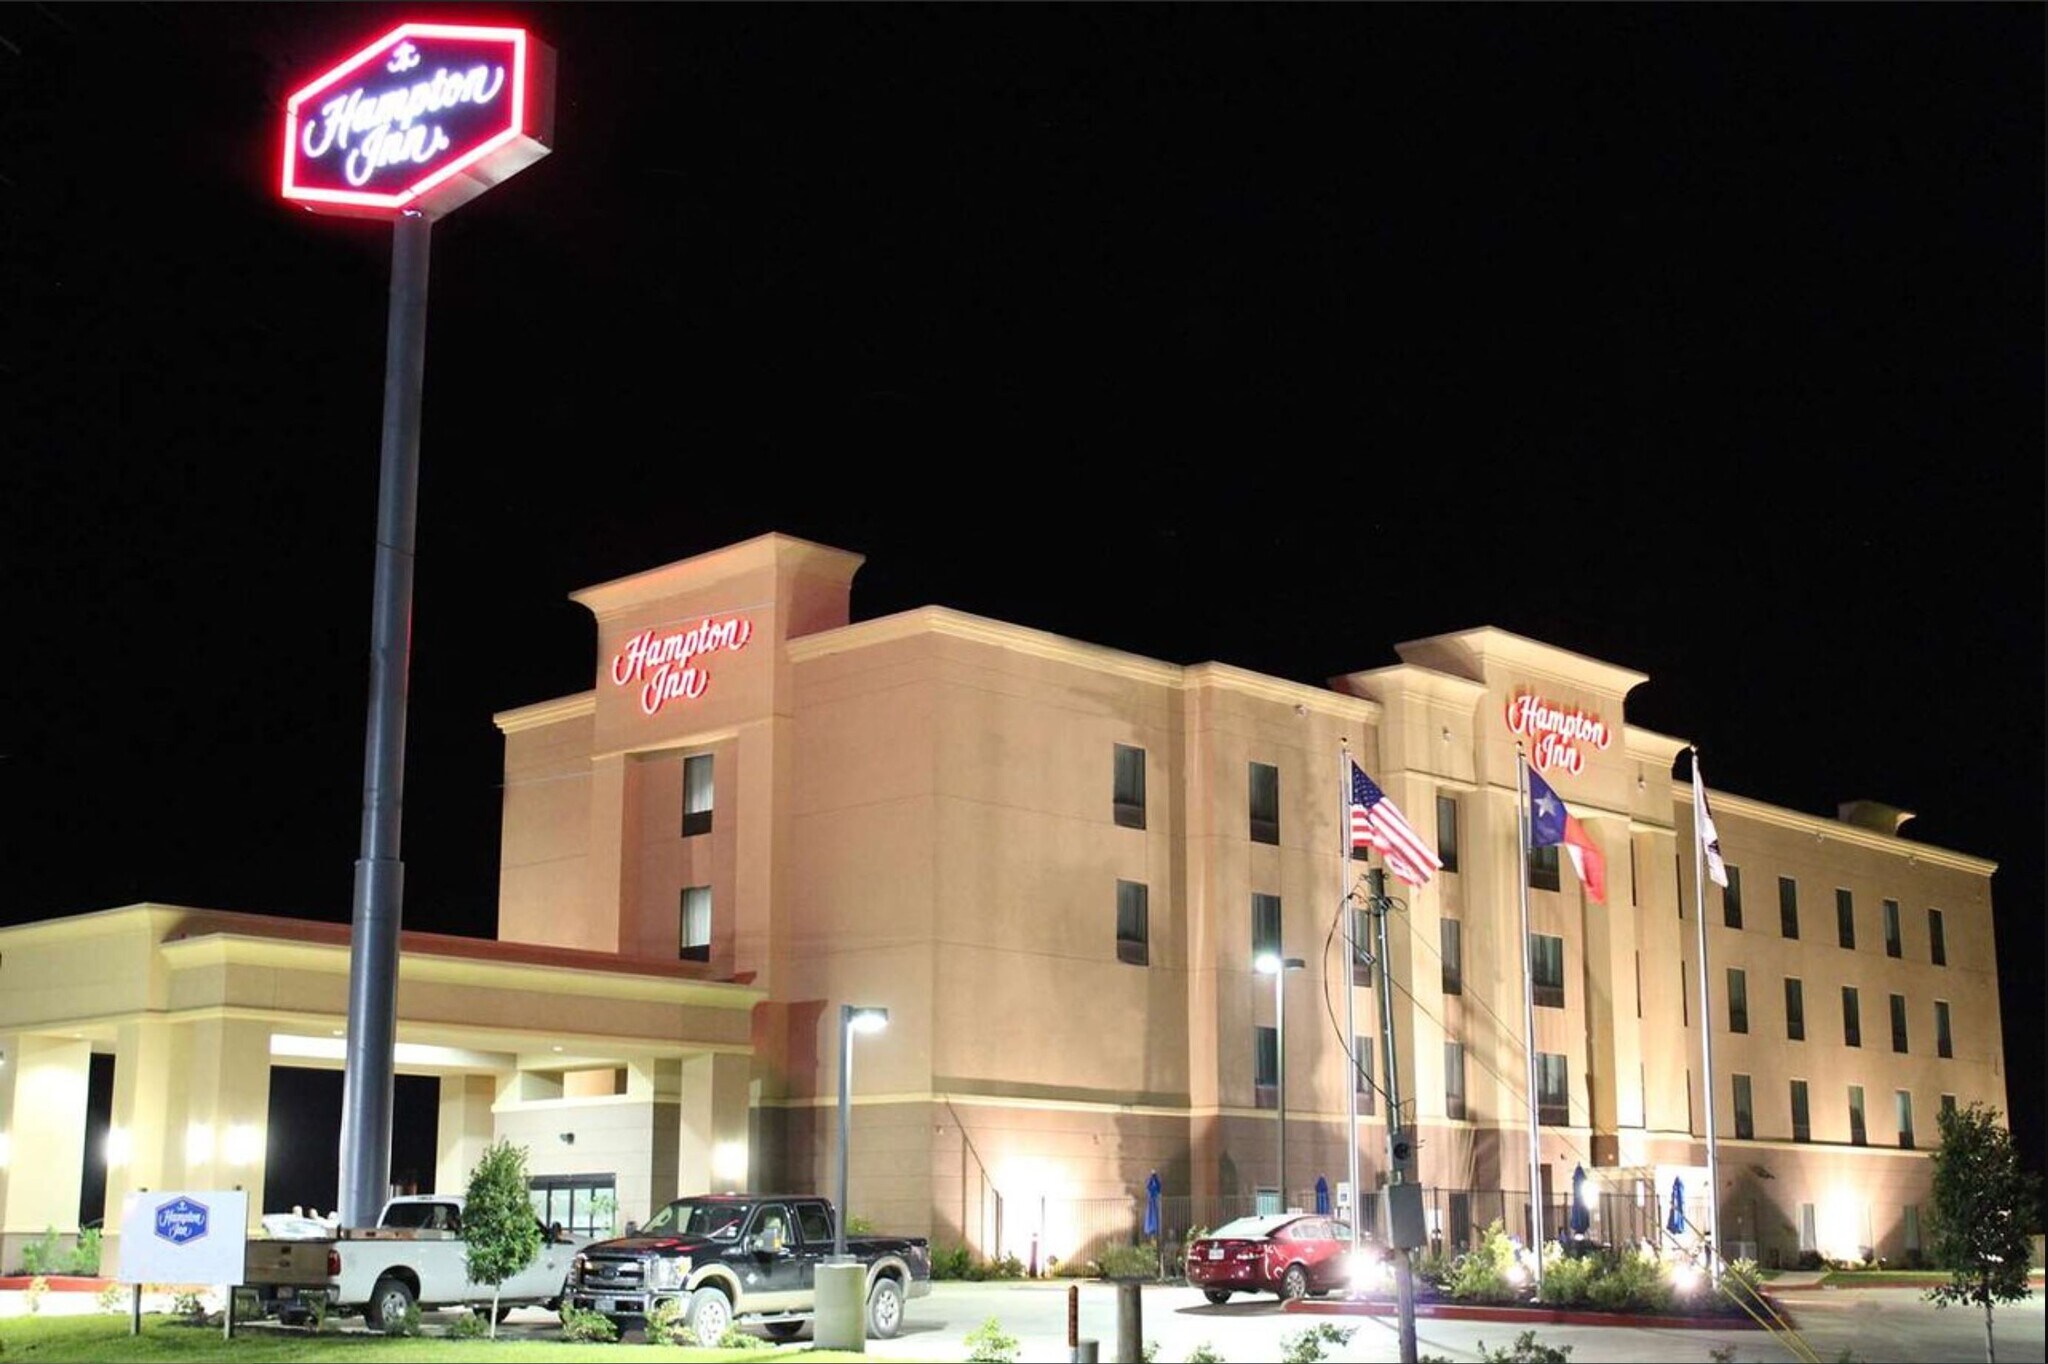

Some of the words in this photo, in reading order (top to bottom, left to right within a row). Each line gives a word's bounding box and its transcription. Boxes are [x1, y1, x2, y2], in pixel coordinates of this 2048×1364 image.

[303, 65, 505, 158] Hampton
[345, 124, 449, 187] Inn
[612, 619, 750, 685] Hampton
[641, 664, 709, 715] Inn
[1507, 695, 1612, 750] Hampton
[1534, 733, 1585, 775] Inn
